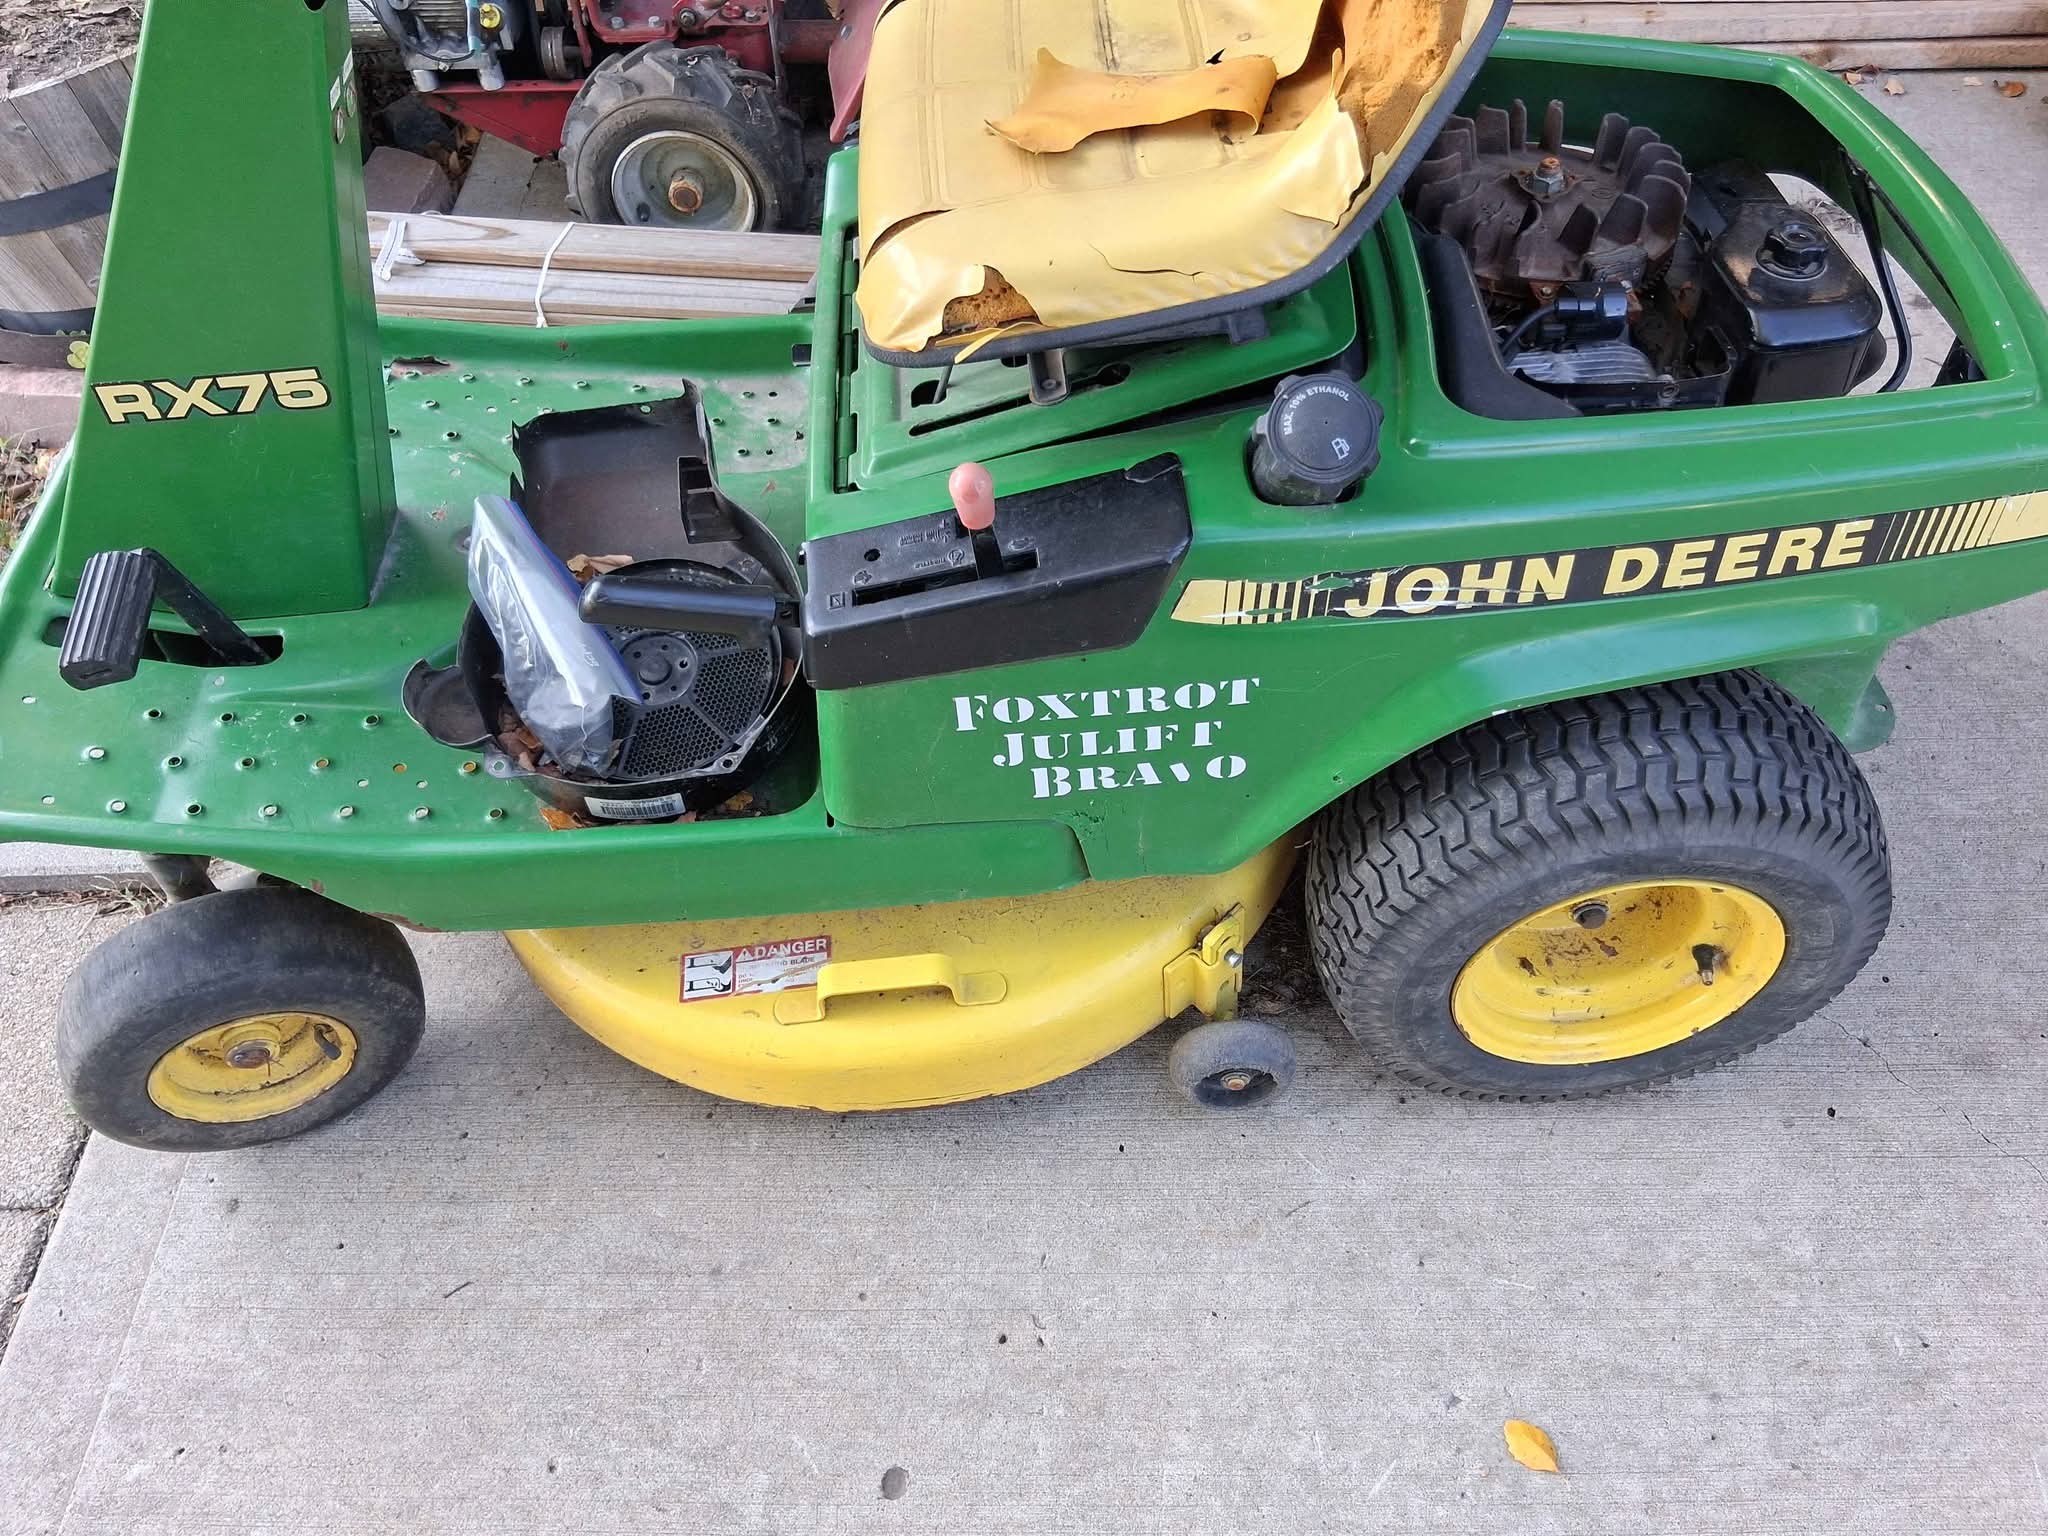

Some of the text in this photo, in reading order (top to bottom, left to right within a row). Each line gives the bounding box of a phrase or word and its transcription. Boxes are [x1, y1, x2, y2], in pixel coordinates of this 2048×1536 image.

[92, 367, 330, 424] RX75
[1289, 392, 1307, 409] 10%
[1306, 385, 1350, 402] ETHANOL
[1343, 519, 1875, 618] JOHN DEERE
[952, 677, 1260, 732] FOXTROT
[1030, 755, 1247, 799] BRAVO
[754, 938, 827, 958] DANGER
